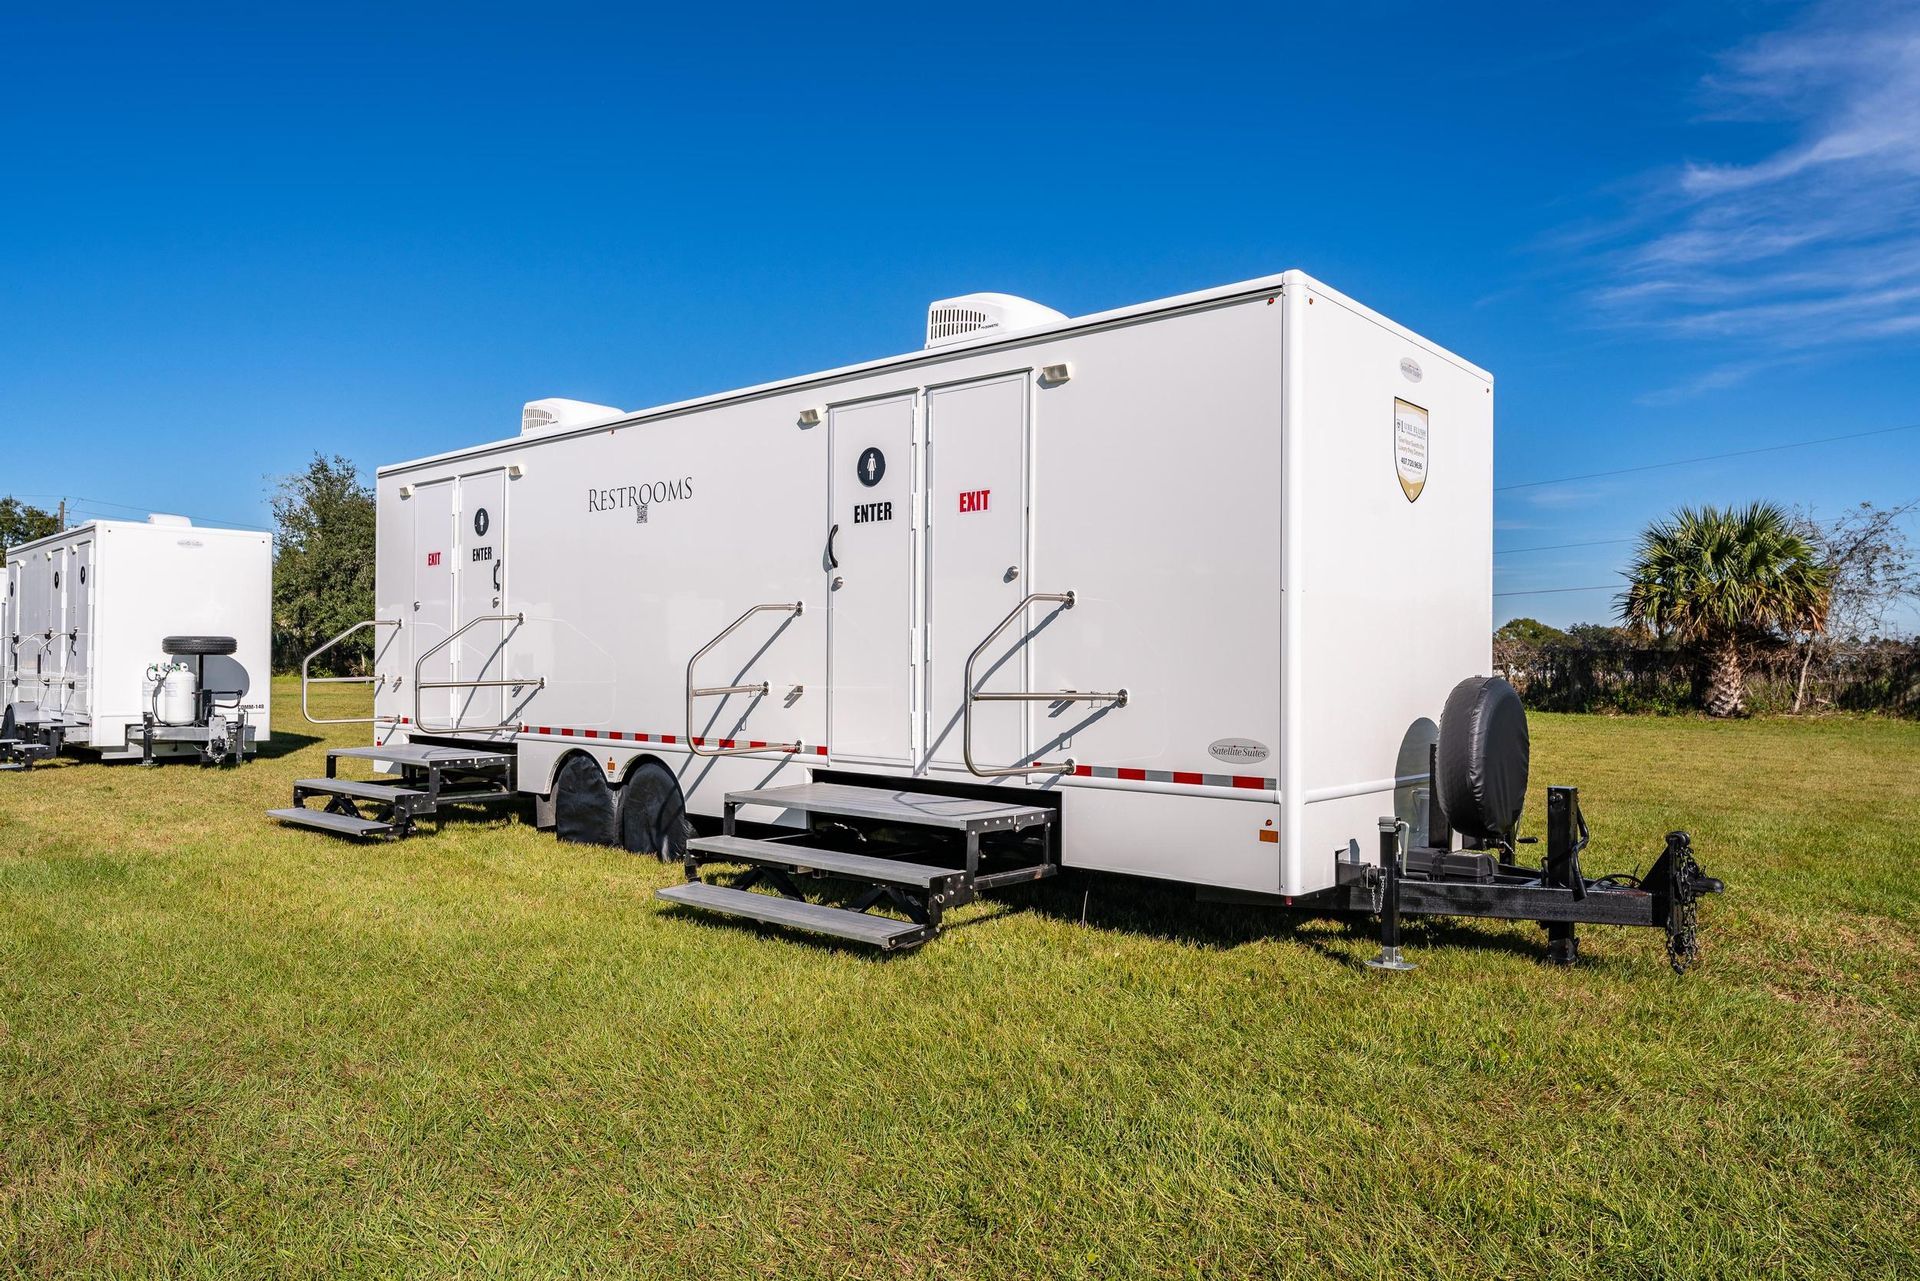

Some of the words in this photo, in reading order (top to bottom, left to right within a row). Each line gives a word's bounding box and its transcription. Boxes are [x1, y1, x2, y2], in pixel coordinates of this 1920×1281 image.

[588, 476, 693, 513] RESTROOMS
[959, 489, 991, 513] EXIT
[854, 501, 892, 524] ENTER
[428, 552, 441, 566] EXIT
[472, 546, 492, 562] ENTER
[1211, 746, 1242, 757] Satellite
[1242, 747, 1267, 758] Suites
